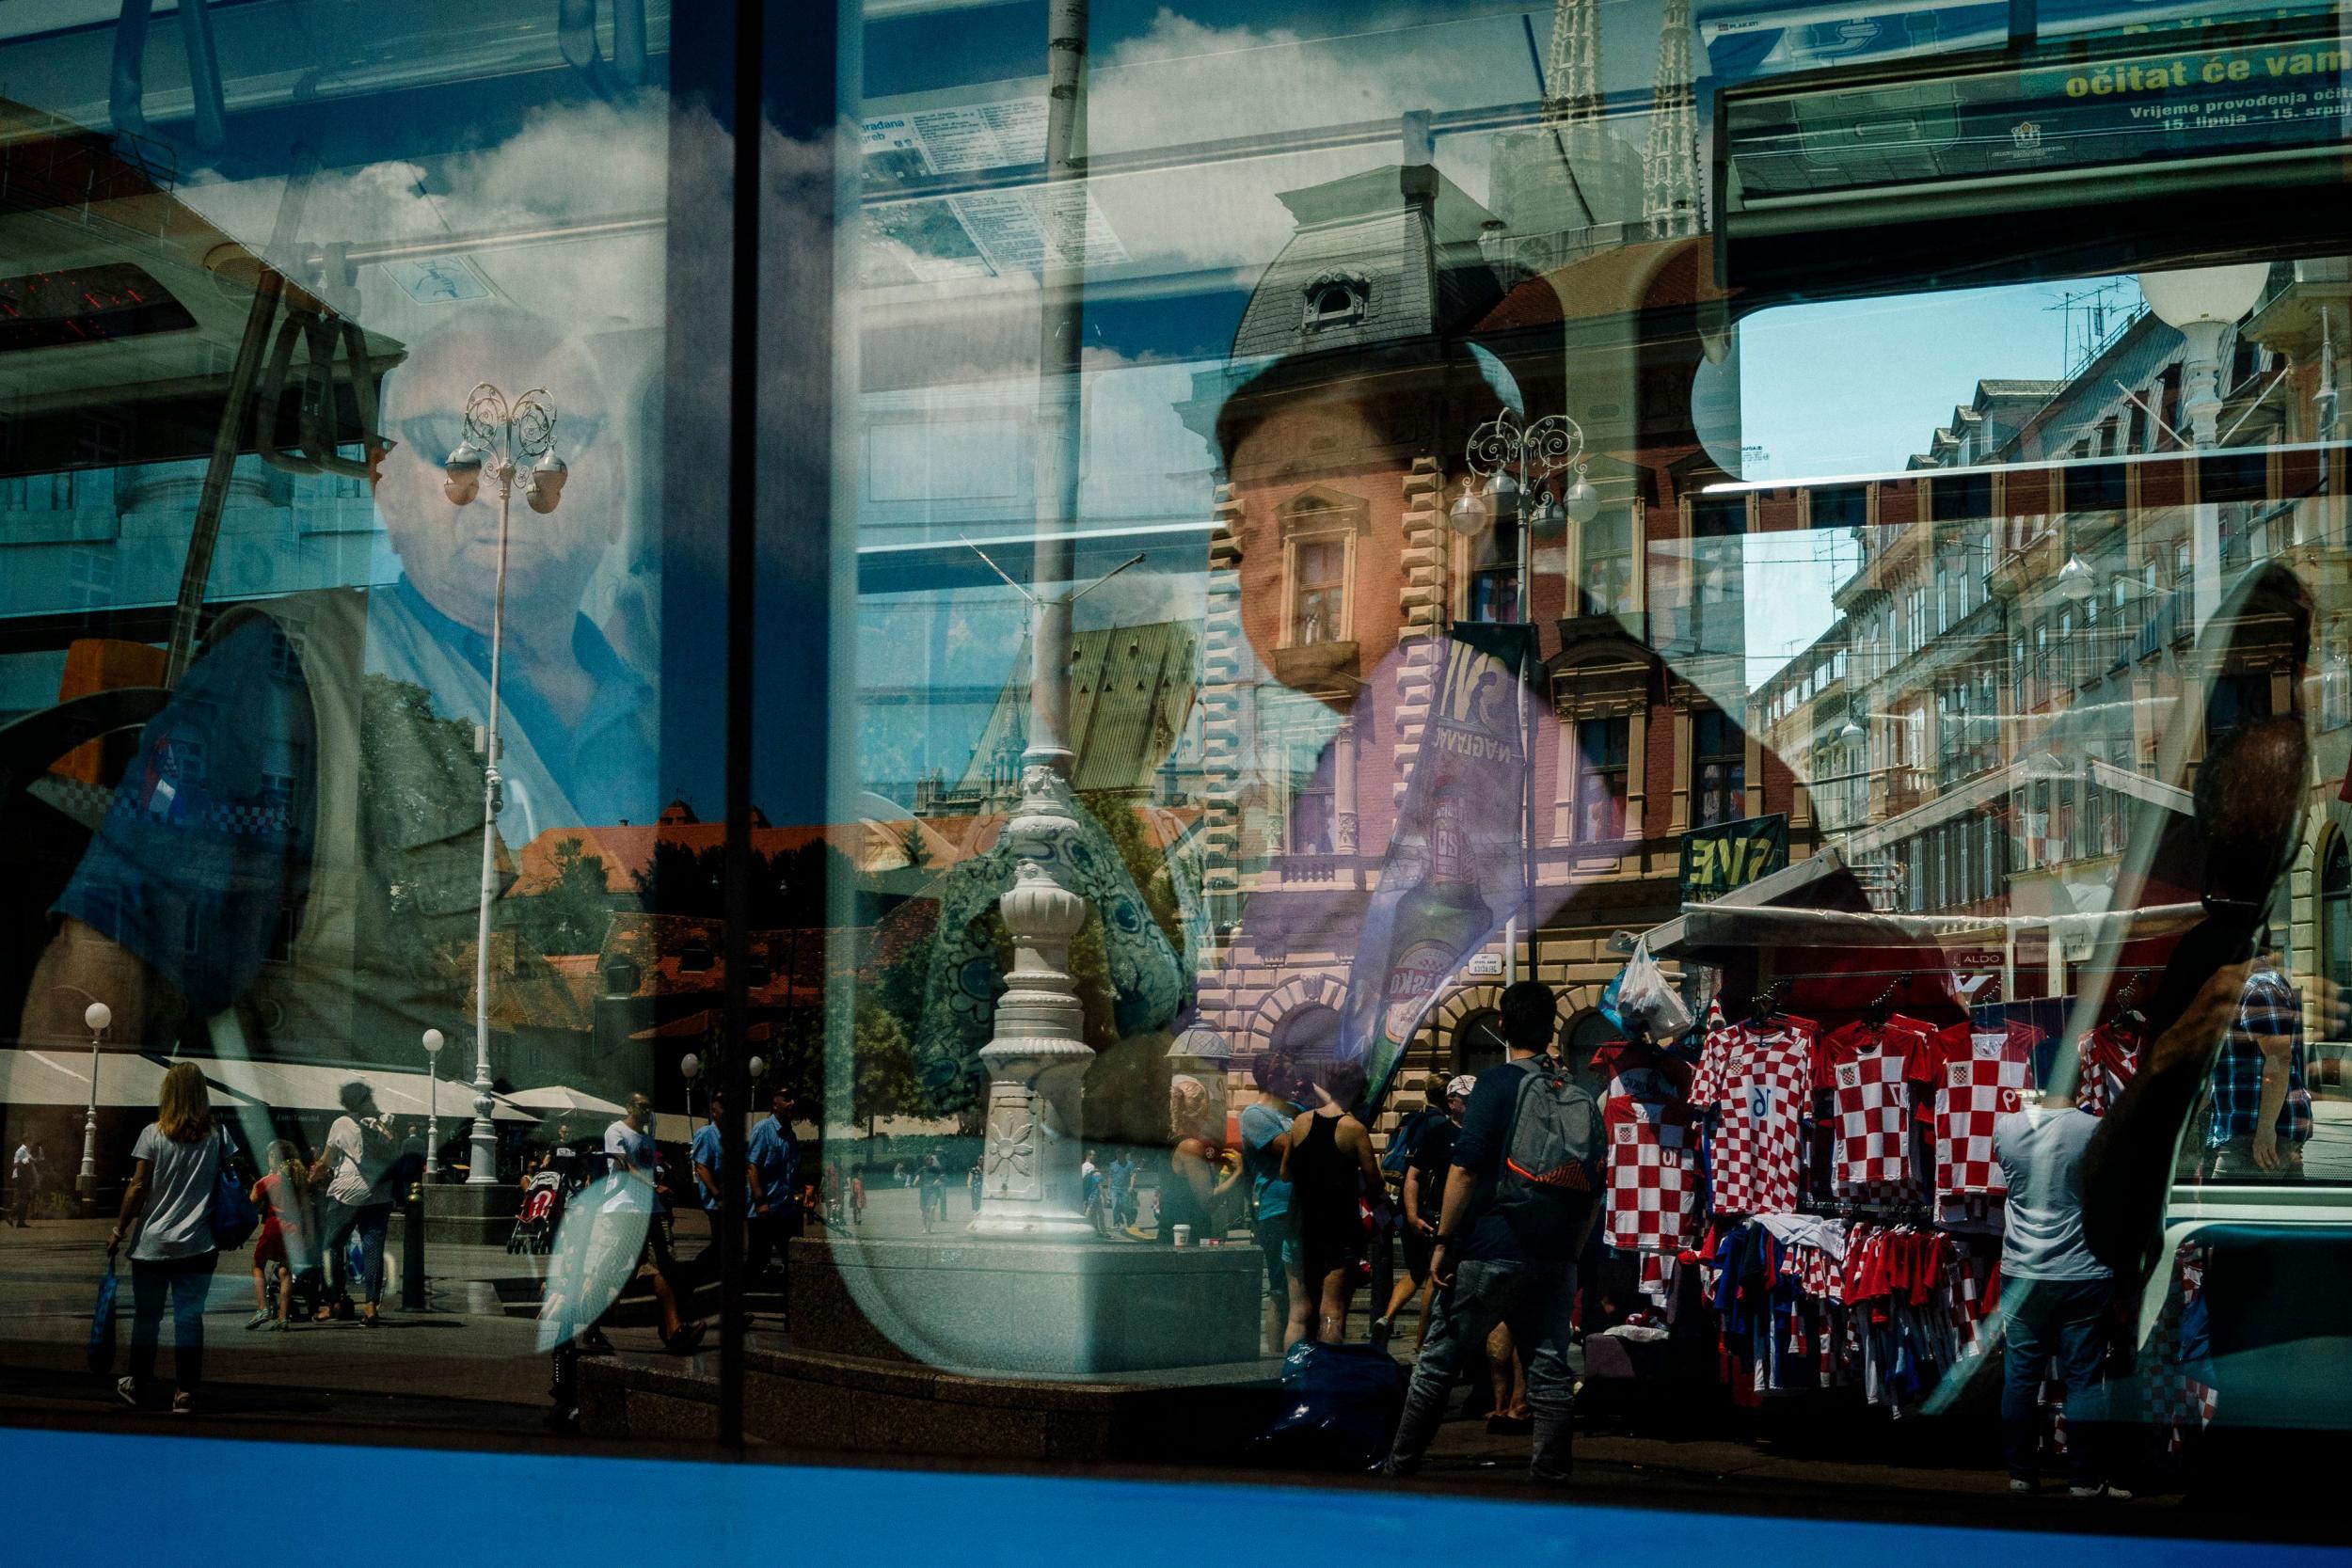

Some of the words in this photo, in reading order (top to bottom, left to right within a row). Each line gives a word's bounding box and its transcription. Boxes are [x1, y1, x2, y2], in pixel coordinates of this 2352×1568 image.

[2064, 60, 2187, 99] očitat
[2201, 55, 2250, 84] će
[2265, 50, 2351, 77] vam
[2130, 103, 2200, 120] Vrijeme
[2205, 92, 2308, 117] provođenja
[2161, 119, 2190, 132] 15.
[2196, 113, 2248, 130] lipnja
[2270, 107, 2300, 119] 15.
[1963, 954, 2001, 964] ALDO
